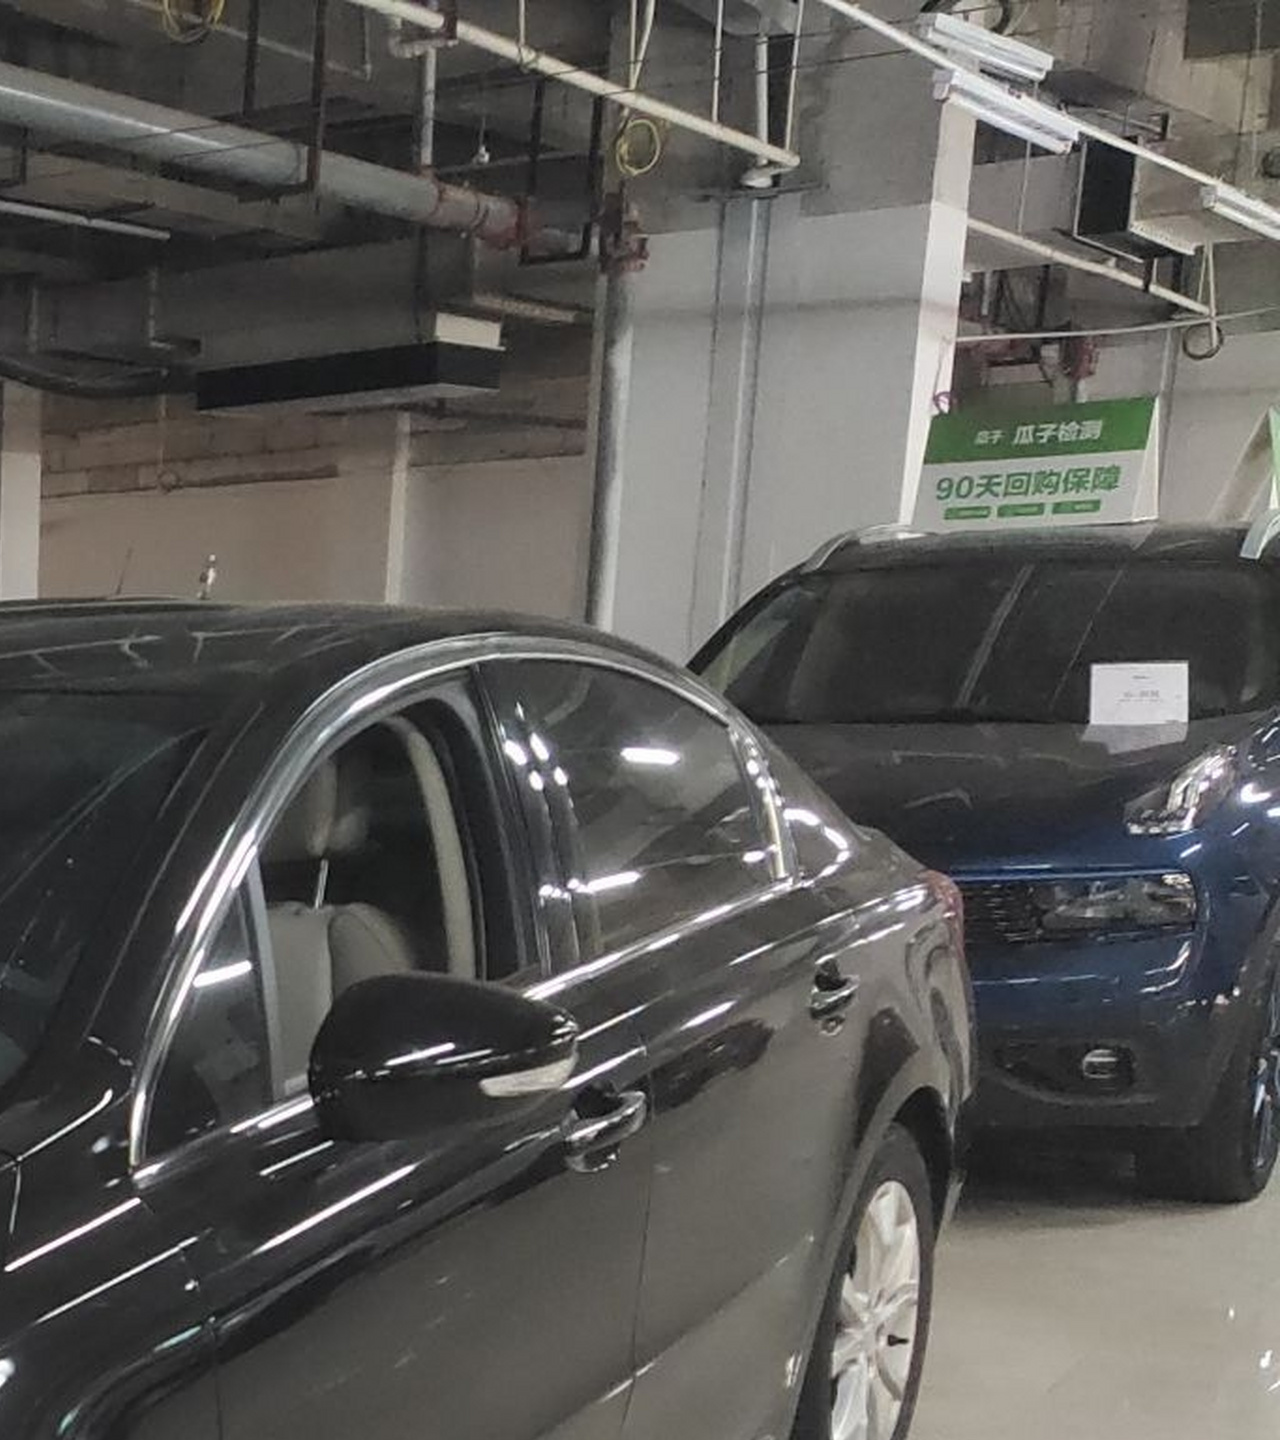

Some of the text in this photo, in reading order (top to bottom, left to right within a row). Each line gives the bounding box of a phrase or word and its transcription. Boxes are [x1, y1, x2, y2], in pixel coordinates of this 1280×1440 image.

[1012, 420, 1103, 445] 瓜子检测
[936, 465, 1121, 500] 90天回购保障
